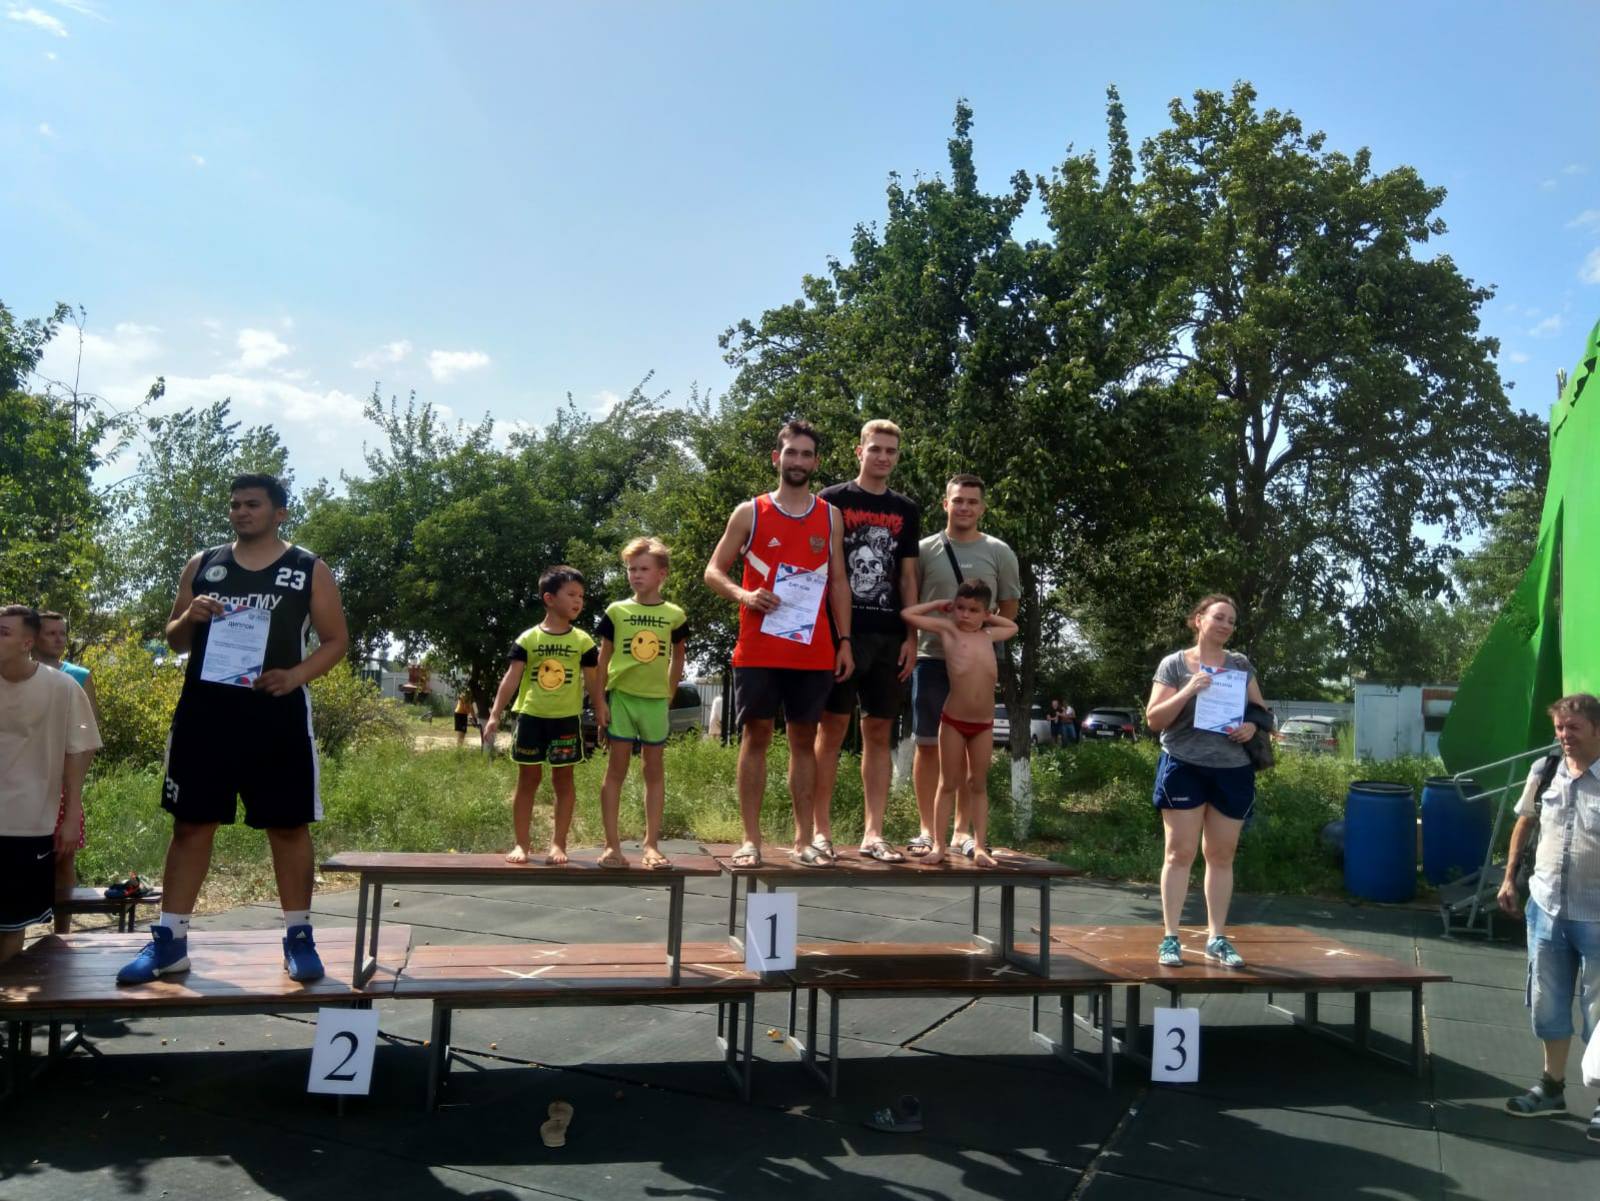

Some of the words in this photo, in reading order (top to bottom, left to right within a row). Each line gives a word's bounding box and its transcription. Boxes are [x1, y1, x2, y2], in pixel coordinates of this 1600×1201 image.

[275, 567, 306, 590] 23
[630, 614, 665, 628] SMILE
[537, 644, 572, 657] SMILE
[765, 913, 781, 960] 1
[323, 1030, 359, 1082] 2
[1164, 1027, 1187, 1072] 3
